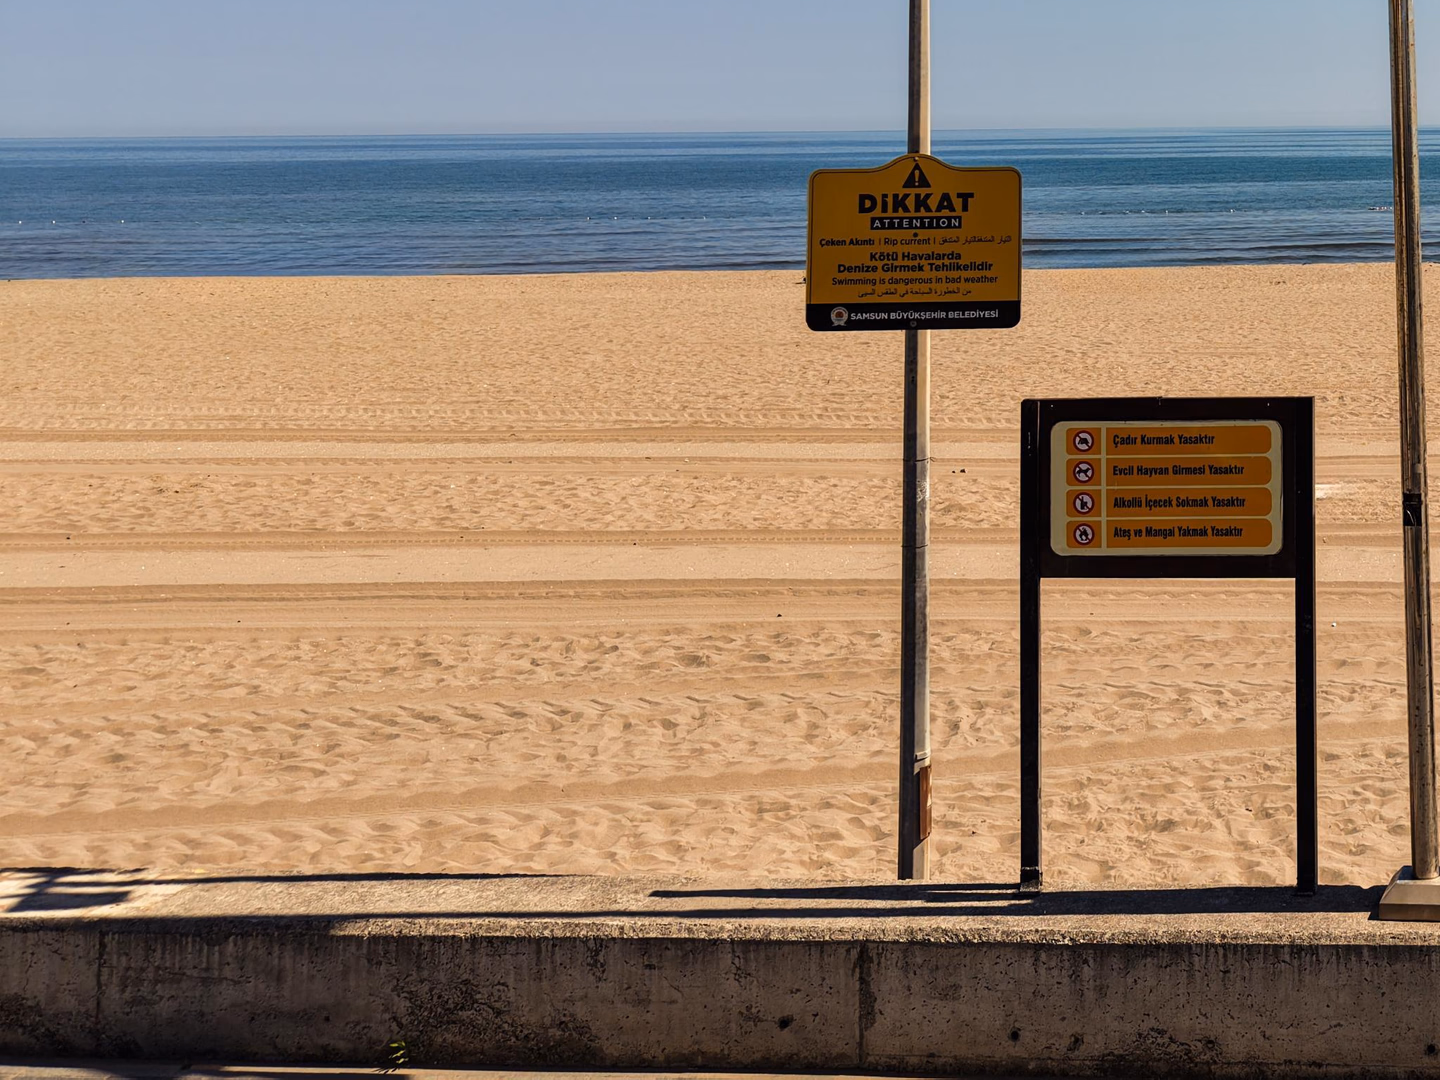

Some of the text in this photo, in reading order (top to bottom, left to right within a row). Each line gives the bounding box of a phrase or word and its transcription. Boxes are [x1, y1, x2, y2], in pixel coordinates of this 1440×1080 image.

[873, 218, 960, 228] ATTENTION
[819, 238, 847, 248] Çeken
[884, 237, 931, 247] Rip current
[870, 251, 962, 262] Kötü Havalarda
[837, 261, 993, 274] Denize Girmek Tehlikelidir
[832, 274, 998, 287] Swimming is dangerous in bad weather
[850, 309, 999, 321] SAMSUN BÜYÜKŞEHİR BELEDİYESİ
[1113, 433, 1215, 447] Çadır Kurmak Yasaktır
[1113, 464, 1244, 478] Evcil Hayvan Girmesi Yasaktır
[1113, 494, 1246, 511] Alkollü İçecek Sokmak Yasaktır
[1113, 525, 1243, 541] Ateş ve Mangal Yakmak Yasaktır
